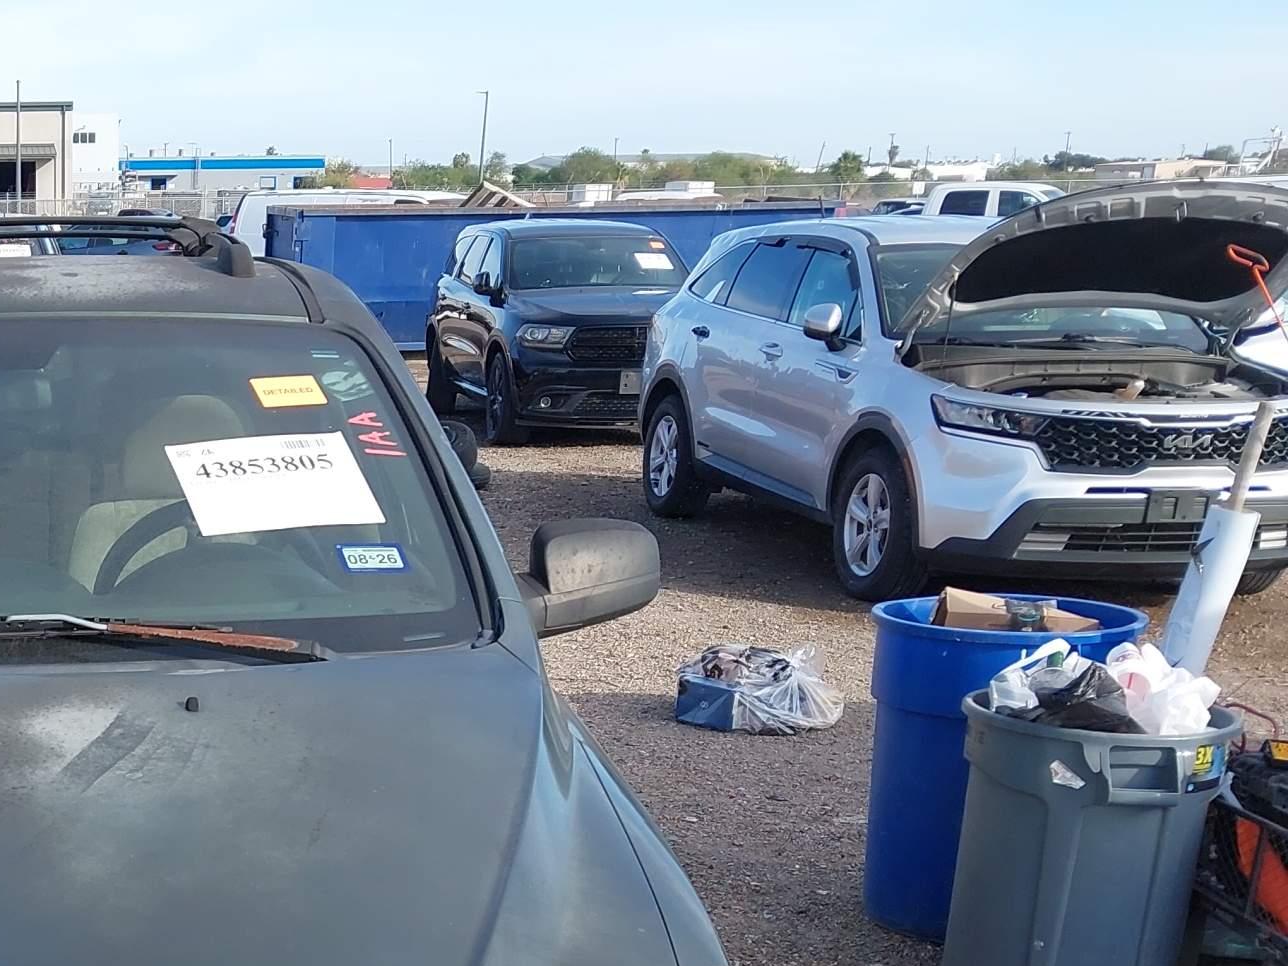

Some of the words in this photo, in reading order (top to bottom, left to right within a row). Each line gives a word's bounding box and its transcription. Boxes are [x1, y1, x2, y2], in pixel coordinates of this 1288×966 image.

[262, 387, 314, 396] DETAILED
[195, 453, 334, 479] 43853805
[1195, 746, 1215, 765] 3X
